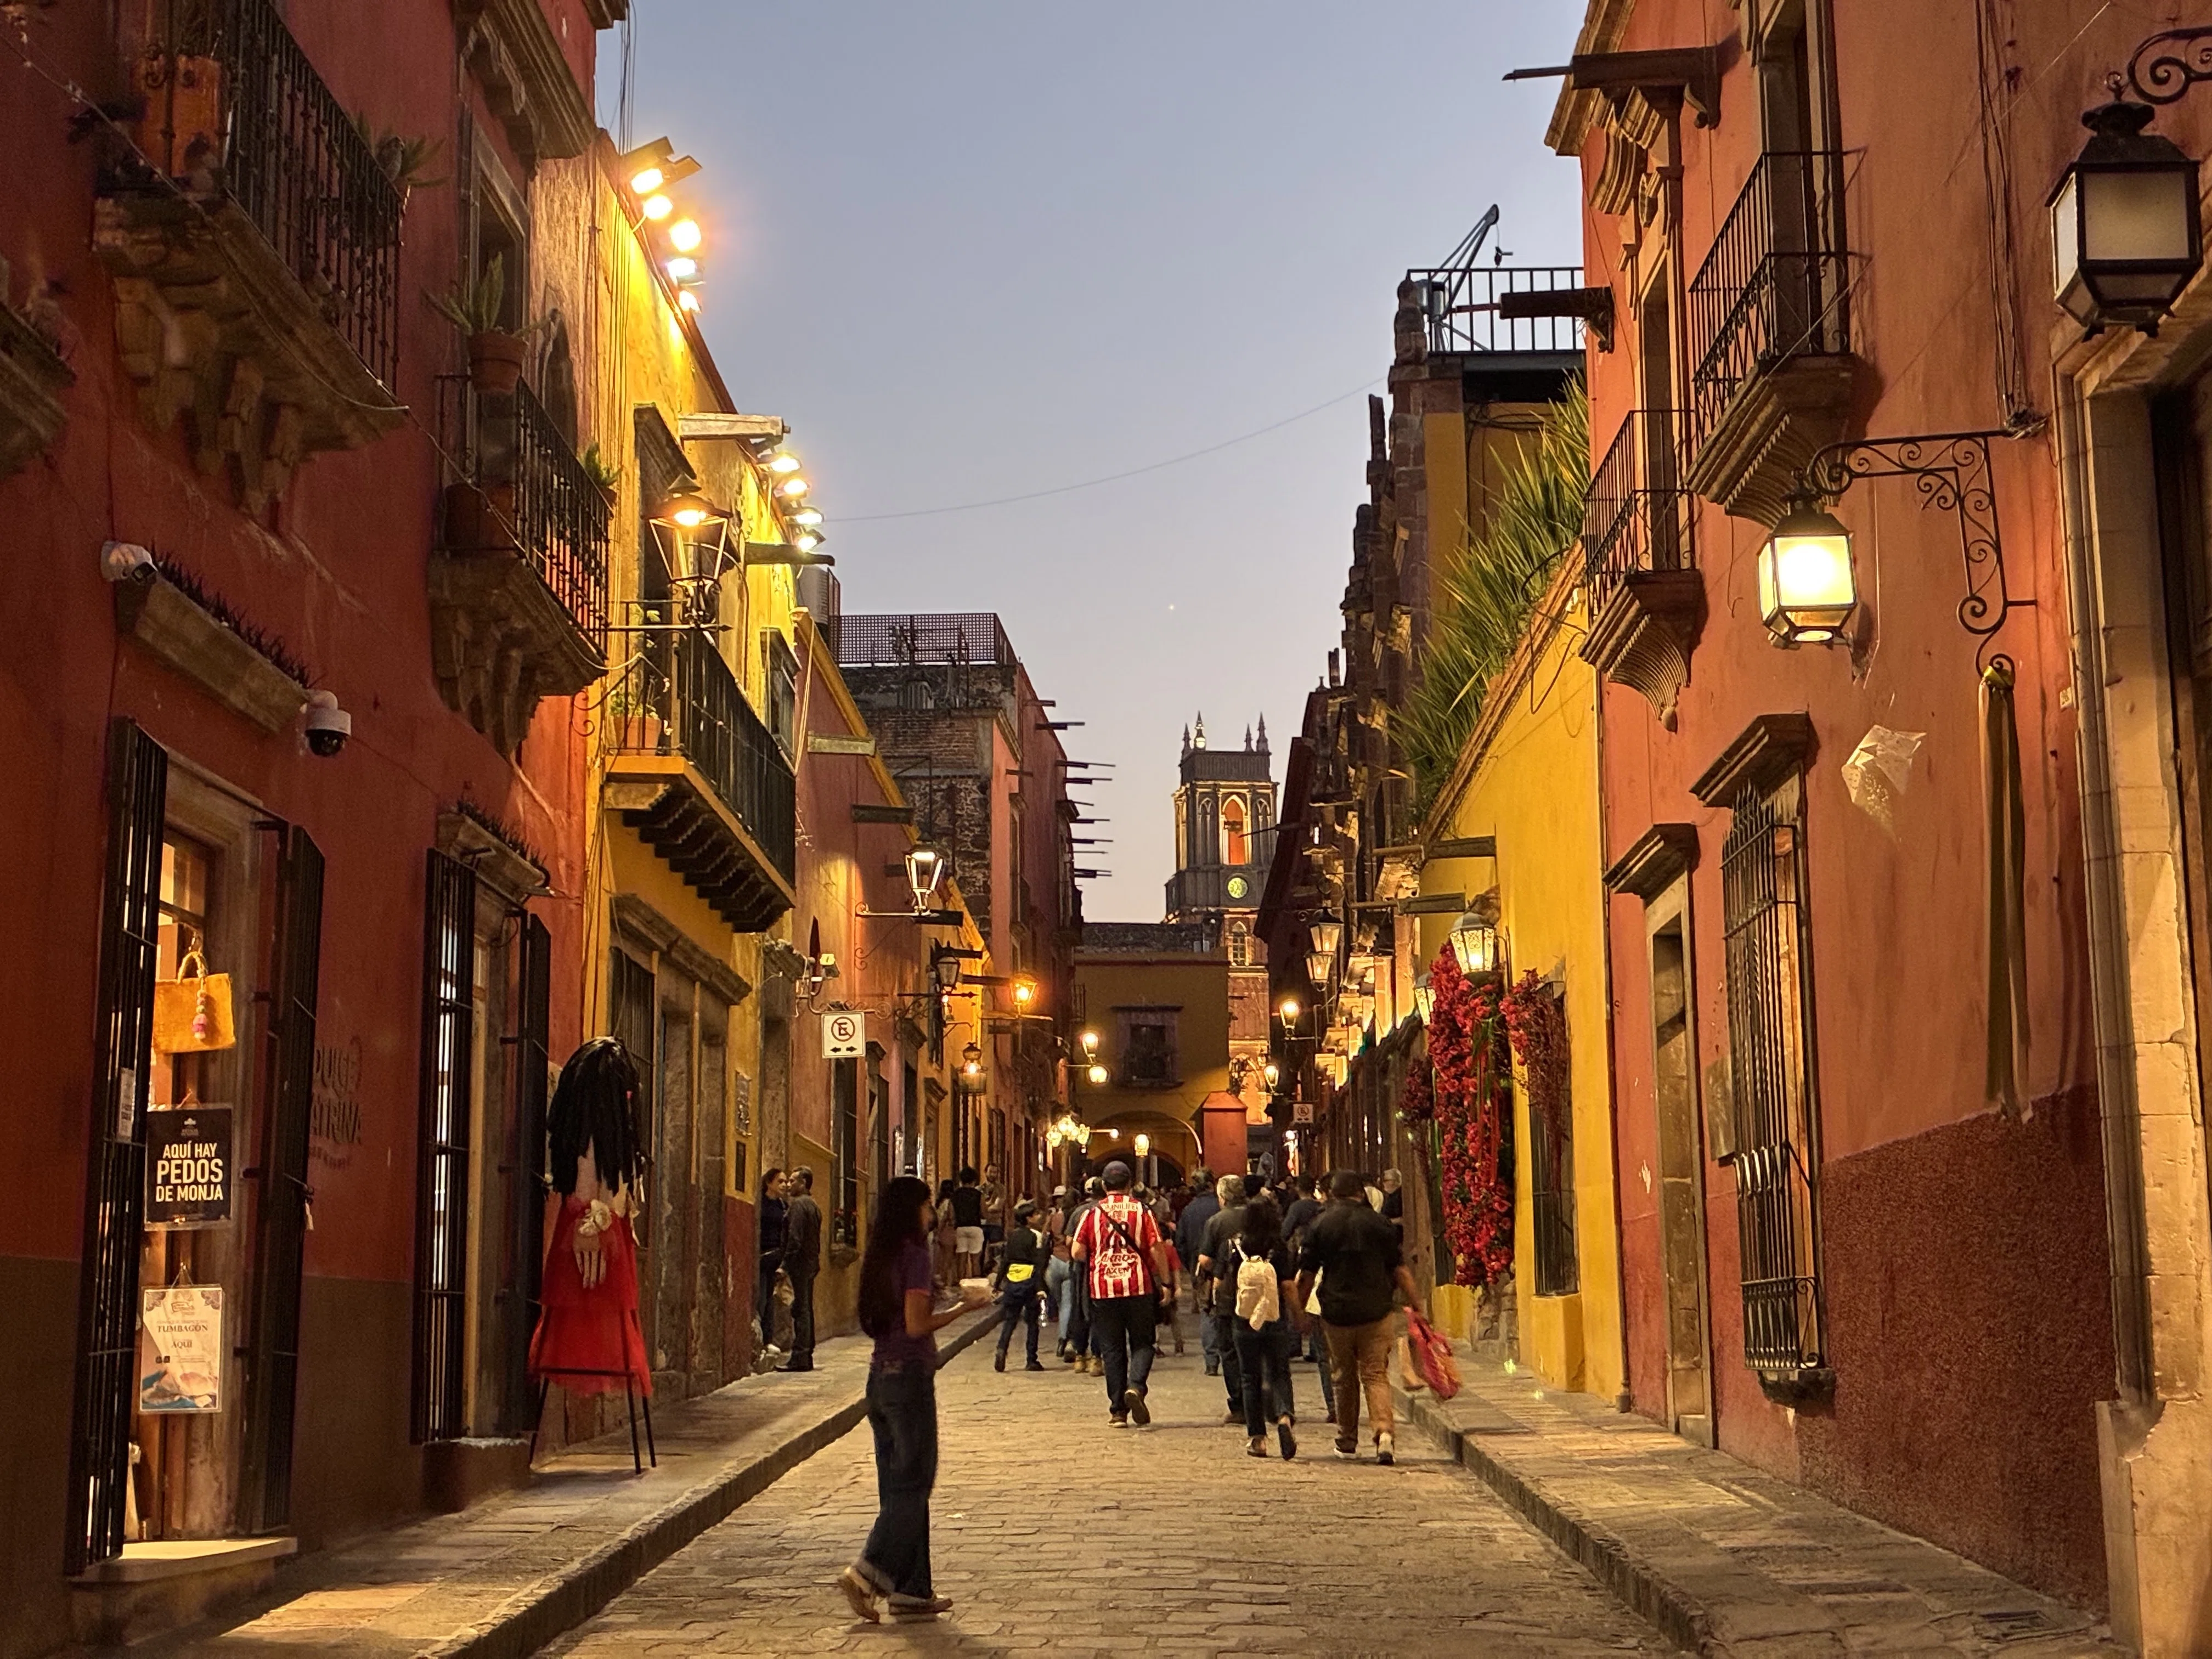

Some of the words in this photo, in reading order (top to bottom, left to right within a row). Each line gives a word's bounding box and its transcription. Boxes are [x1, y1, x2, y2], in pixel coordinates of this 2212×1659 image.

[310, 1097, 362, 1143] ATRINA
[162, 1141, 191, 1159] AQUÍ
[195, 1143, 217, 1158] HAY
[157, 1158, 223, 1184] PEDOS
[156, 1186, 173, 1202] DE
[177, 1184, 223, 1201] MONJA
